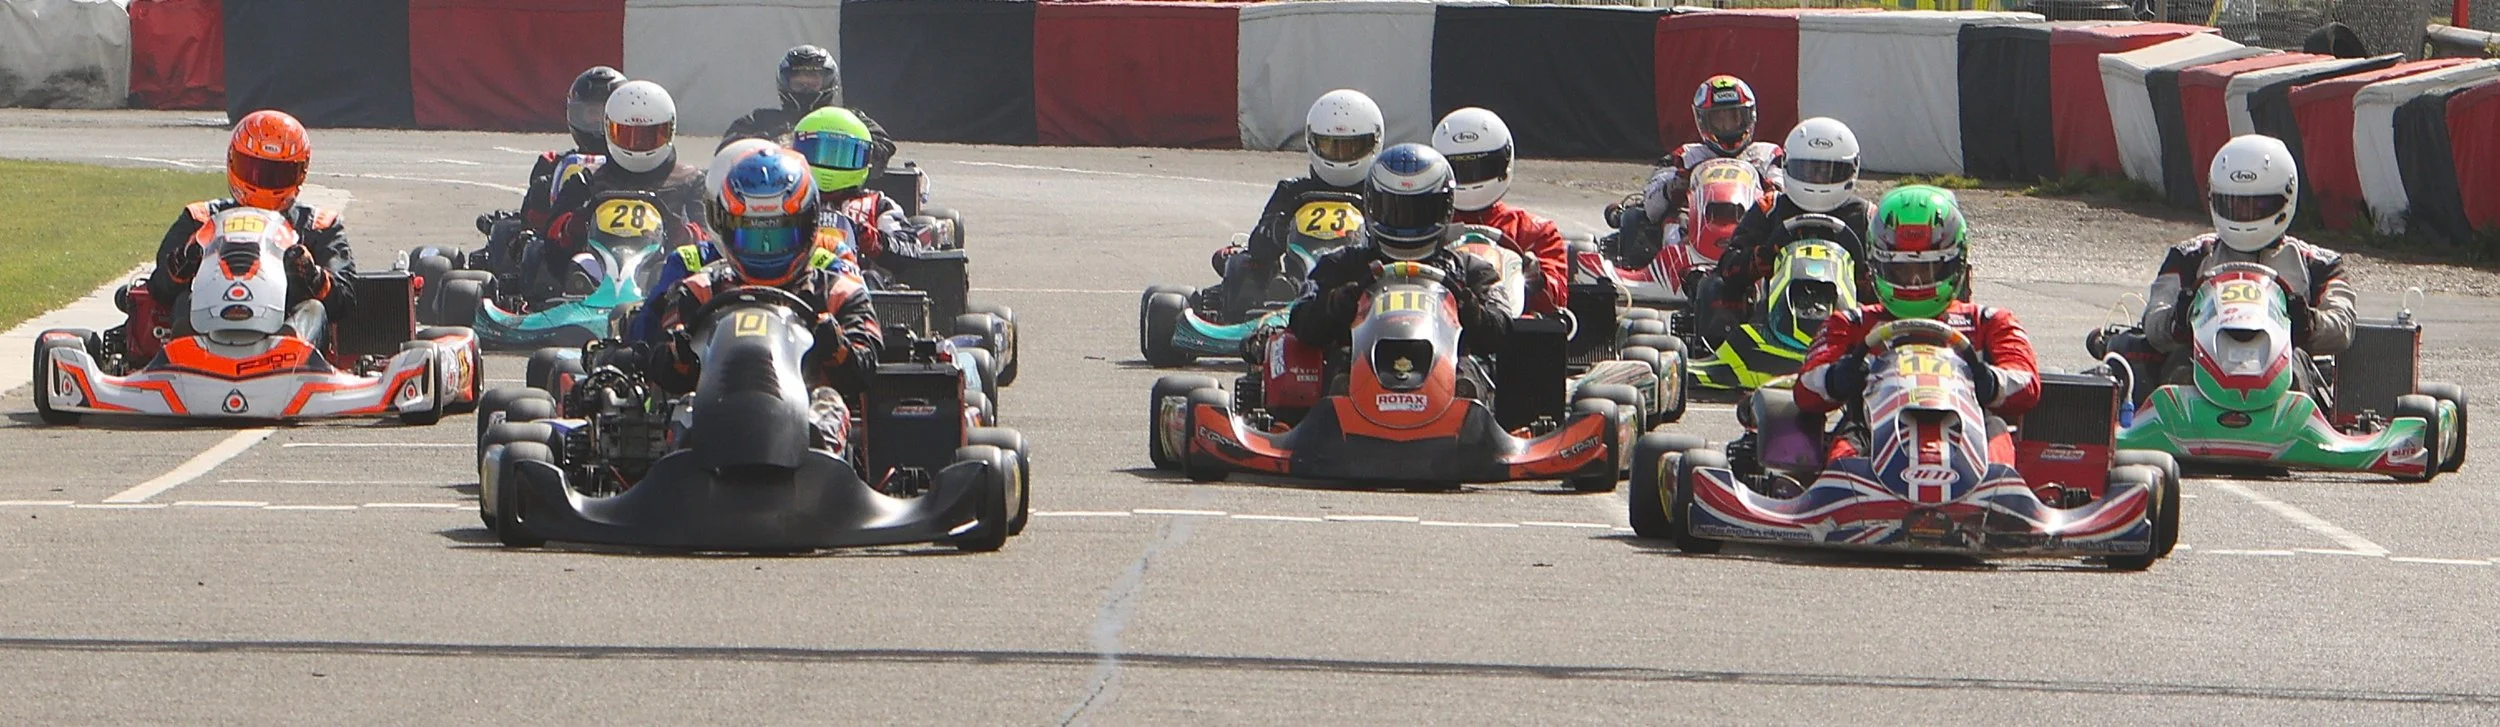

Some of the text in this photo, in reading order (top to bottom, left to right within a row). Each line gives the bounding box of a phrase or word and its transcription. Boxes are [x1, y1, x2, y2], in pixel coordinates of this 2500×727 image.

[2233, 170, 2255, 181] Arai
[610, 204, 645, 229] 28
[1306, 207, 1346, 232] 23
[2221, 284, 2261, 301] 50
[1903, 356, 1943, 373] 17
[1379, 395, 1425, 405] ROTAX
